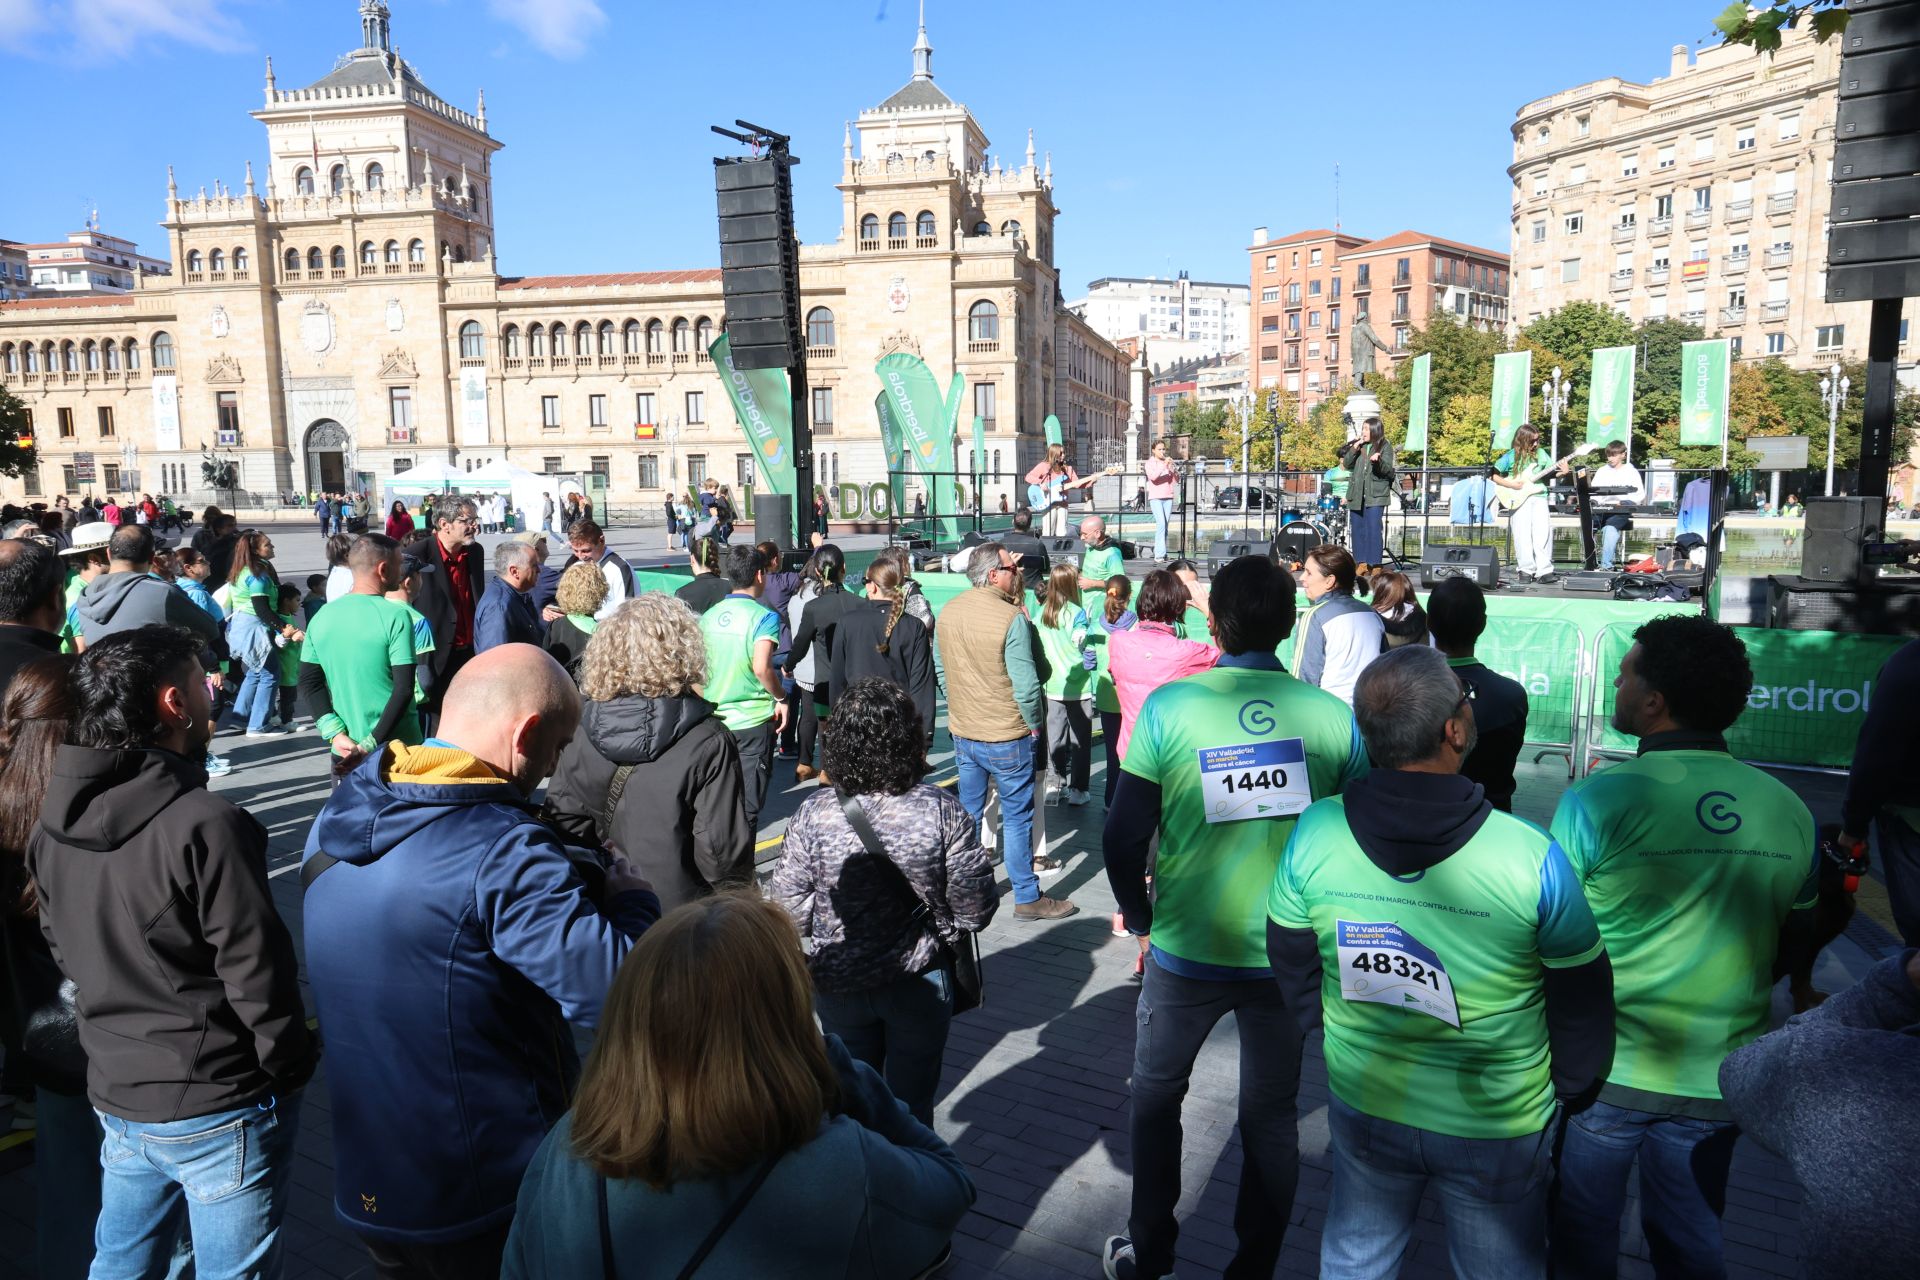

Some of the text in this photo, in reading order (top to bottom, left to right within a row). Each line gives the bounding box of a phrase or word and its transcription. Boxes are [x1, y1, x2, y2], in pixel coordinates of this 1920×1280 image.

[1206, 746, 1256, 759] XIV Valladolid
[1215, 755, 1239, 763] marcha
[1222, 768, 1288, 793] 1440
[1734, 849, 1762, 857] CONTRA
[1334, 891, 1375, 901] VALLADOLID
[1386, 896, 1417, 906] MARCHA
[1418, 902, 1448, 912] CONTRA
[1345, 925, 1403, 937] XIV Valladolid
[1352, 952, 1440, 992] 48321
